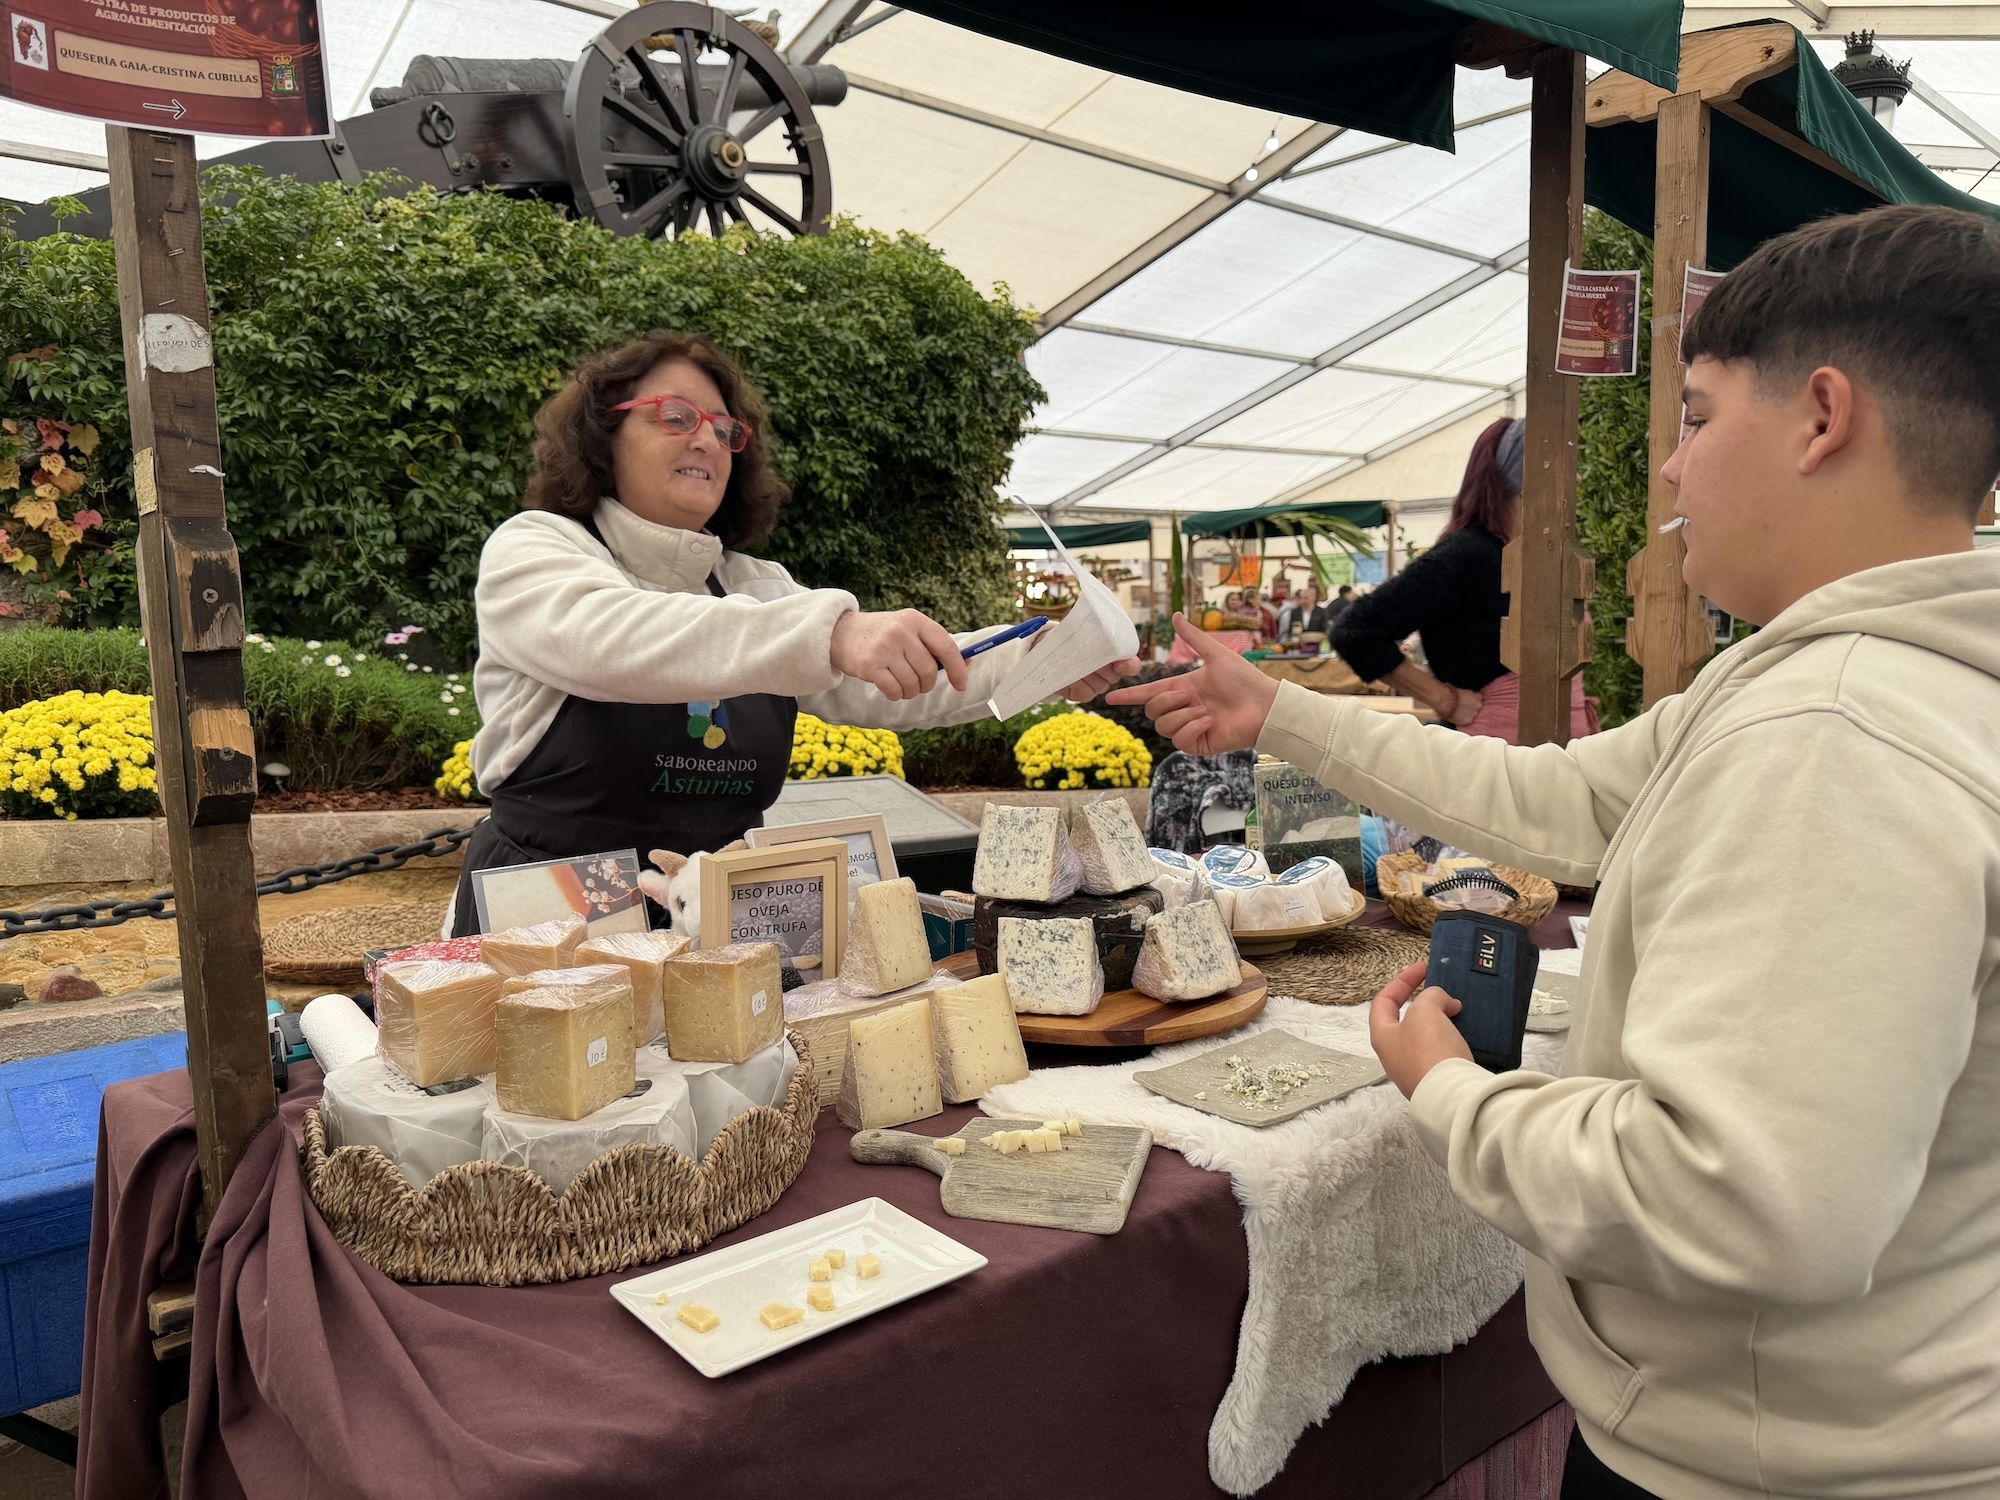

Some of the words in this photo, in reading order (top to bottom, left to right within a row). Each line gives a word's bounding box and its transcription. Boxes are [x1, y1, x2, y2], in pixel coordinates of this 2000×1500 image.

[82, 0, 128, 12] STRA
[131, 4, 148, 15] DE
[150, 7, 219, 24] PRODUCTOS
[220, 15, 236, 25] DE
[95, 8, 216, 36] AGROALIMENTACIÓN
[60, 47, 117, 67] QUESERÍA
[119, 60, 205, 80] GAIA-CRISTINA
[208, 72, 259, 84] CUBILLAS
[1589, 285, 1614, 293] CASTAÑA
[649, 768, 755, 796] Asturias
[1263, 779, 1299, 791] QUESO
[1285, 792, 1331, 805] INTENSO
[767, 882, 804, 897] PURO
[749, 903, 790, 918] OVEJA
[731, 926, 761, 939] CON
[765, 920, 808, 935] TRUFA
